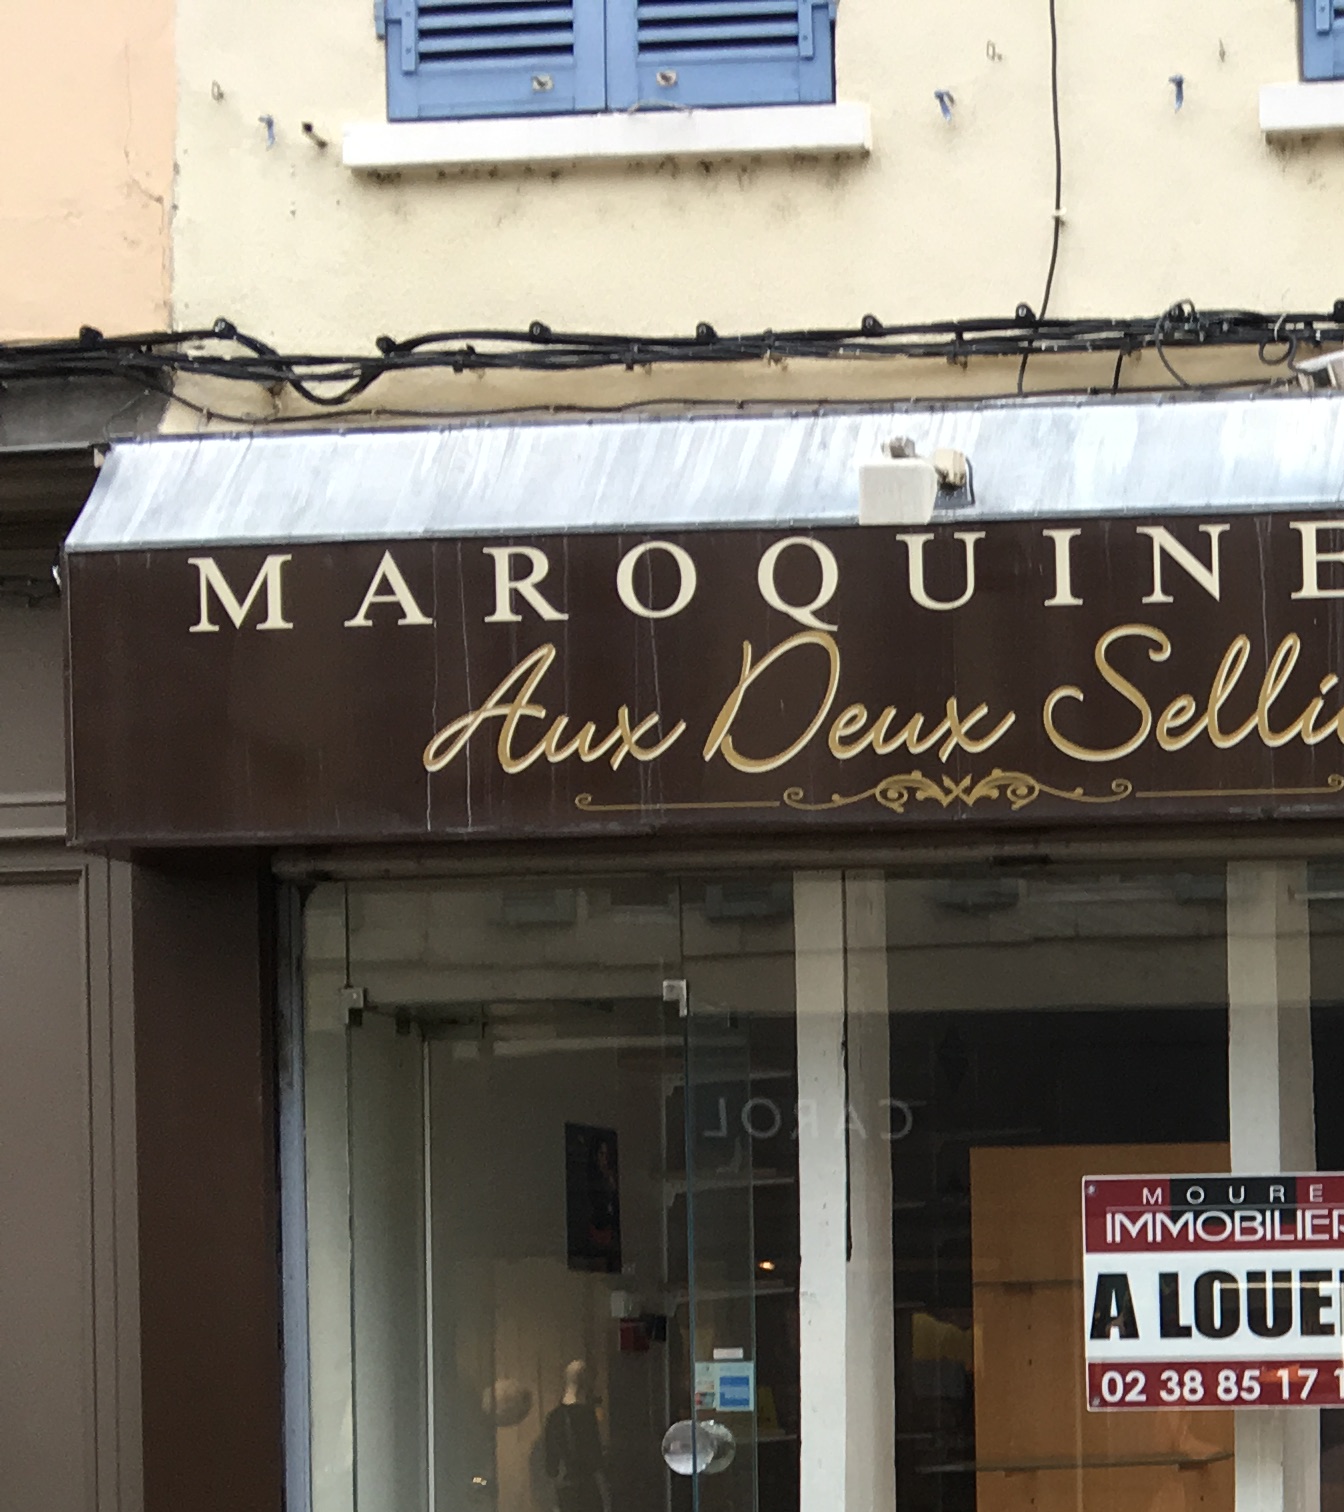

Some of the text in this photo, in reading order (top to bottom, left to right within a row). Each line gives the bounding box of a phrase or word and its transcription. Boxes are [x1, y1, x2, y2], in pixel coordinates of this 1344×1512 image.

[422, 642, 687, 776] Aux
[703, 629, 1017, 777] Deux
[1142, 1184, 1324, 1206] MOURE
[1089, 1272, 1140, 1340] A
[1101, 1369, 1147, 1402] 02
[1159, 1369, 1205, 1401] 38
[1216, 1368, 1262, 1401] 85
[1276, 1368, 1319, 1400] 17
